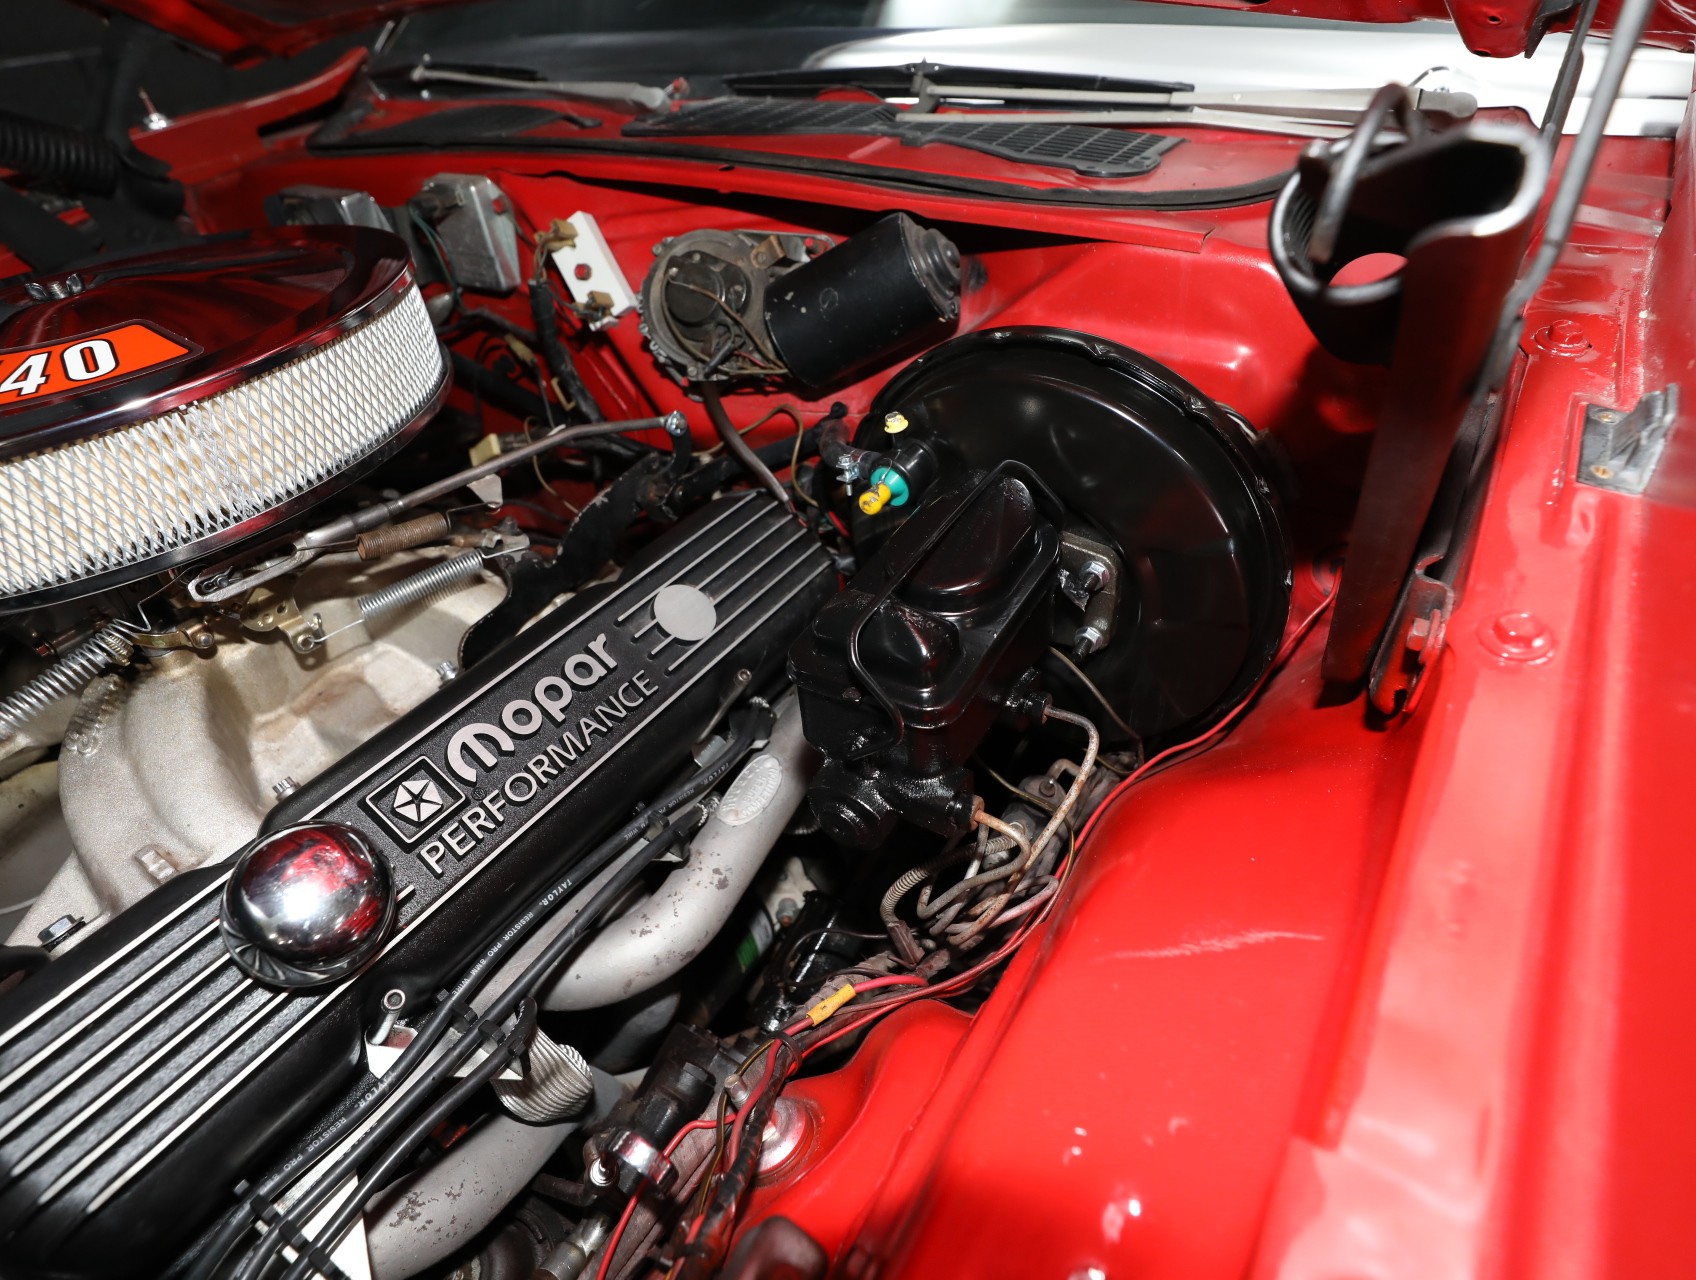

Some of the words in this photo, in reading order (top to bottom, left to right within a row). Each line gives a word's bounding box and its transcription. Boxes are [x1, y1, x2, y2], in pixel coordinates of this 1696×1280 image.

[0, 338, 119, 397] 40
[447, 633, 618, 782] Mopar
[419, 669, 659, 875] PERFORMANCE
[502, 911, 534, 941] RESISTOR
[487, 941, 503, 957] PRO
[470, 958, 487, 977] 8MM
[451, 978, 469, 996] WIRE
[307, 1116, 347, 1153] RESISTOR
[283, 1153, 304, 1172] PRO
